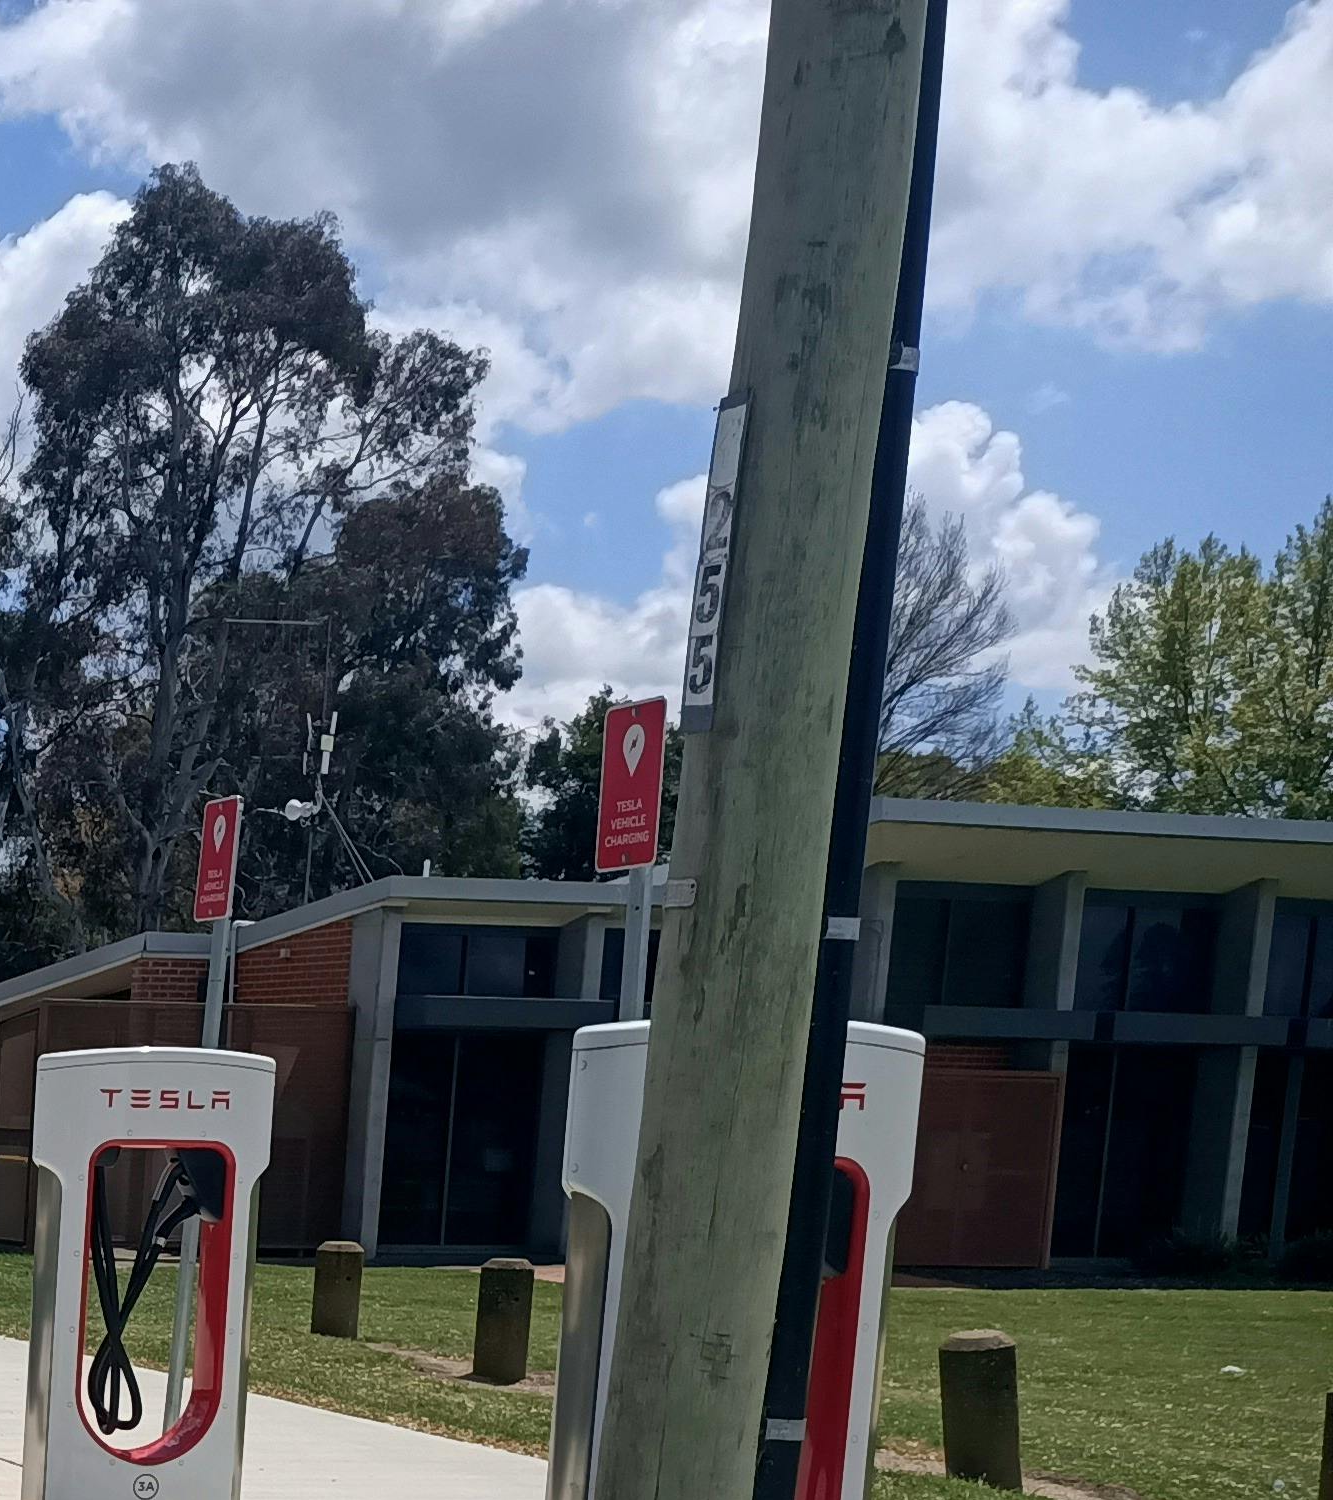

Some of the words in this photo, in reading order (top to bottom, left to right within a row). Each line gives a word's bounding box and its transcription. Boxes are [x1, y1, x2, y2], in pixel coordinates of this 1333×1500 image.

[616, 798, 643, 813] TESLA
[610, 814, 647, 830] VEHICLE
[604, 830, 650, 848] CHARGING
[99, 1088, 232, 1111] TESLA
[137, 1481, 155, 1492] 3A
